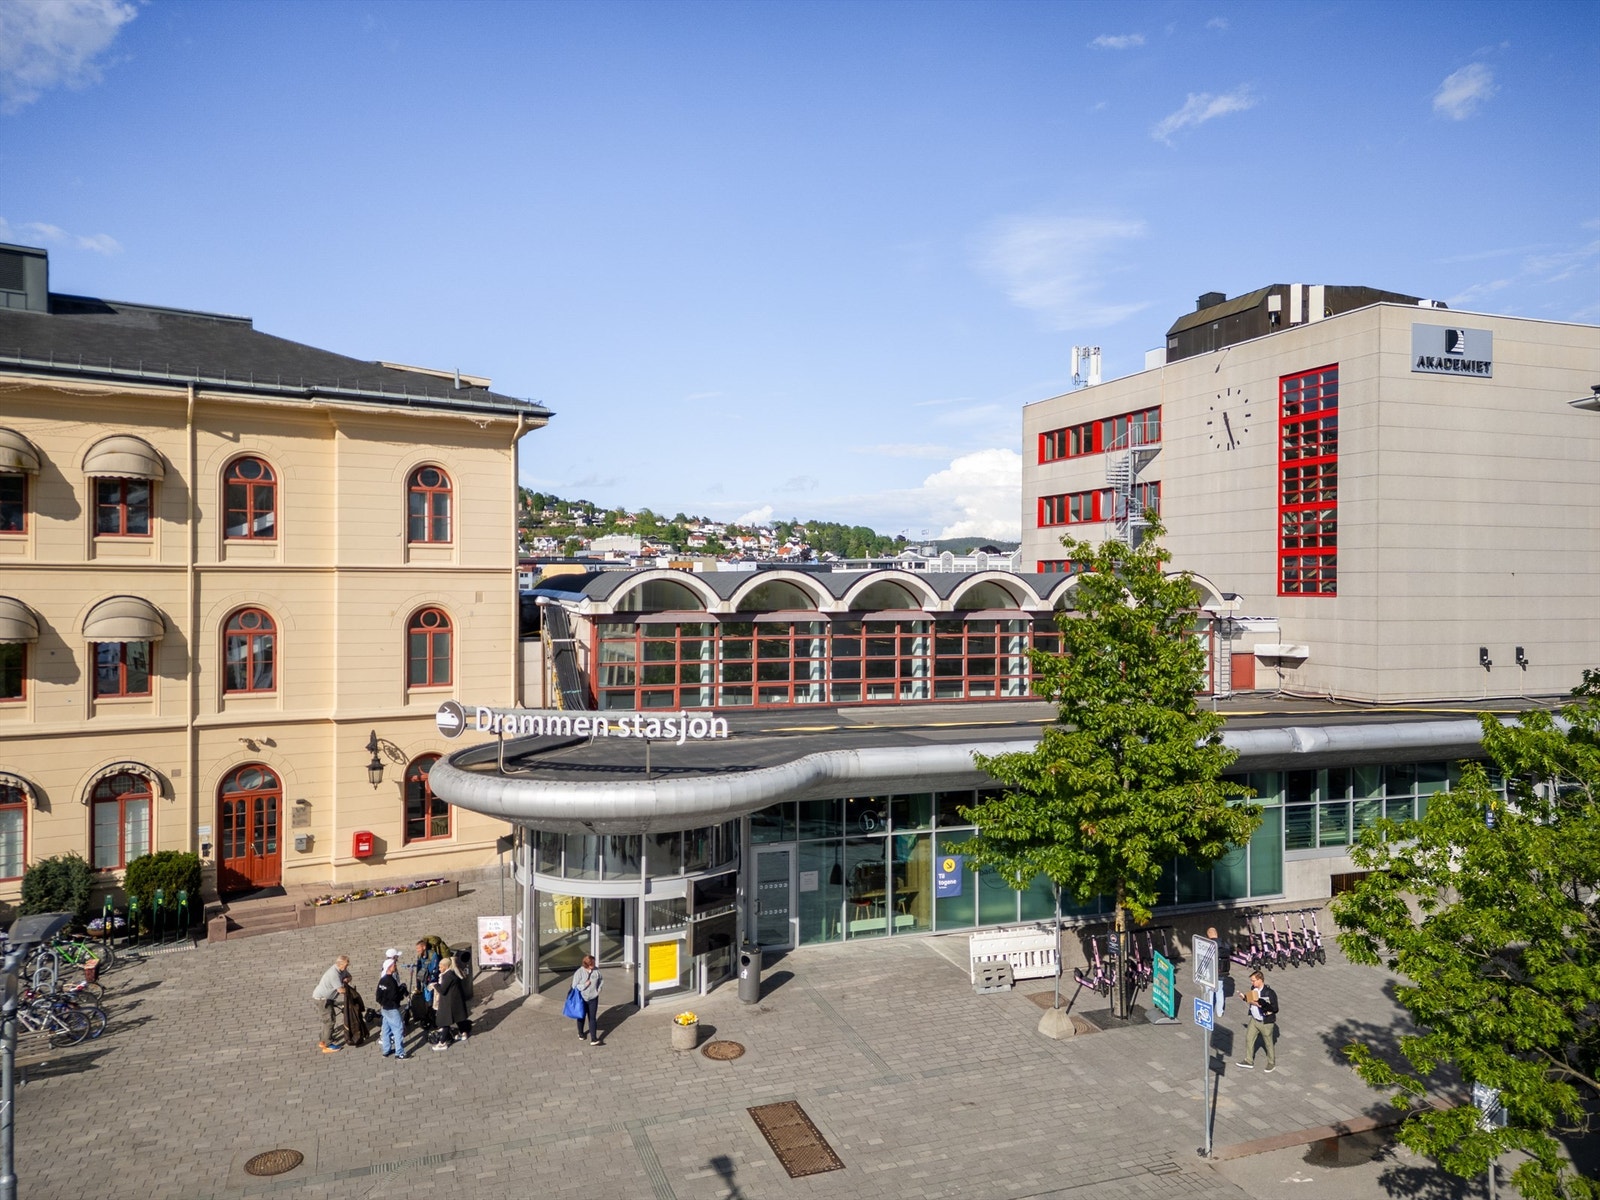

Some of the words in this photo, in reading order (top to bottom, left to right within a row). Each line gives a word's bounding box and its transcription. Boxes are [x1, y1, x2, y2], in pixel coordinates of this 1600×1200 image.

[1416, 355, 1491, 374] AKADEMIET
[475, 706, 608, 737] Drammen
[617, 710, 728, 745] stasjon
